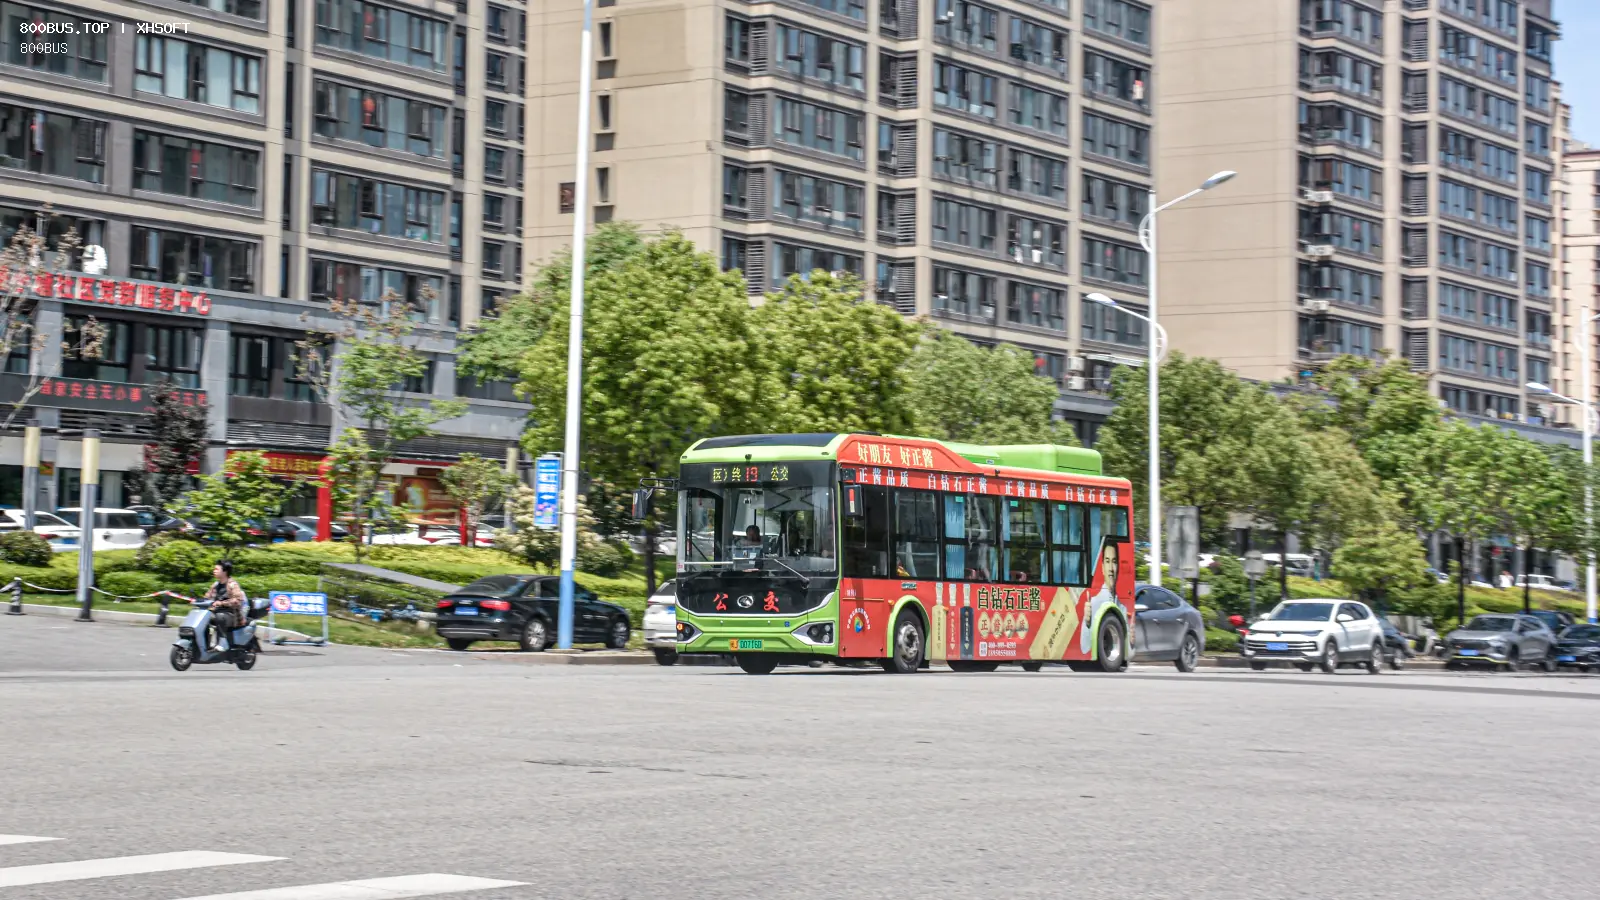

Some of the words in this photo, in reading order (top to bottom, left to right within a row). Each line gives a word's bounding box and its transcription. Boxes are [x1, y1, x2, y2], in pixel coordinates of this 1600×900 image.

[857, 441, 893, 465] 好朋友
[899, 445, 934, 468] 好正酱
[745, 466, 759, 482] 19
[770, 466, 789, 481] 公交
[858, 467, 909, 488] 正酱品质
[927, 473, 988, 494] 白钻石正酱
[1004, 480, 1049, 500] 正酱品质
[1065, 485, 1118, 505] 白钻石正酱
[712, 593, 729, 611] 公
[763, 591, 780, 612] 交
[977, 587, 1041, 611] 白钻石正酱
